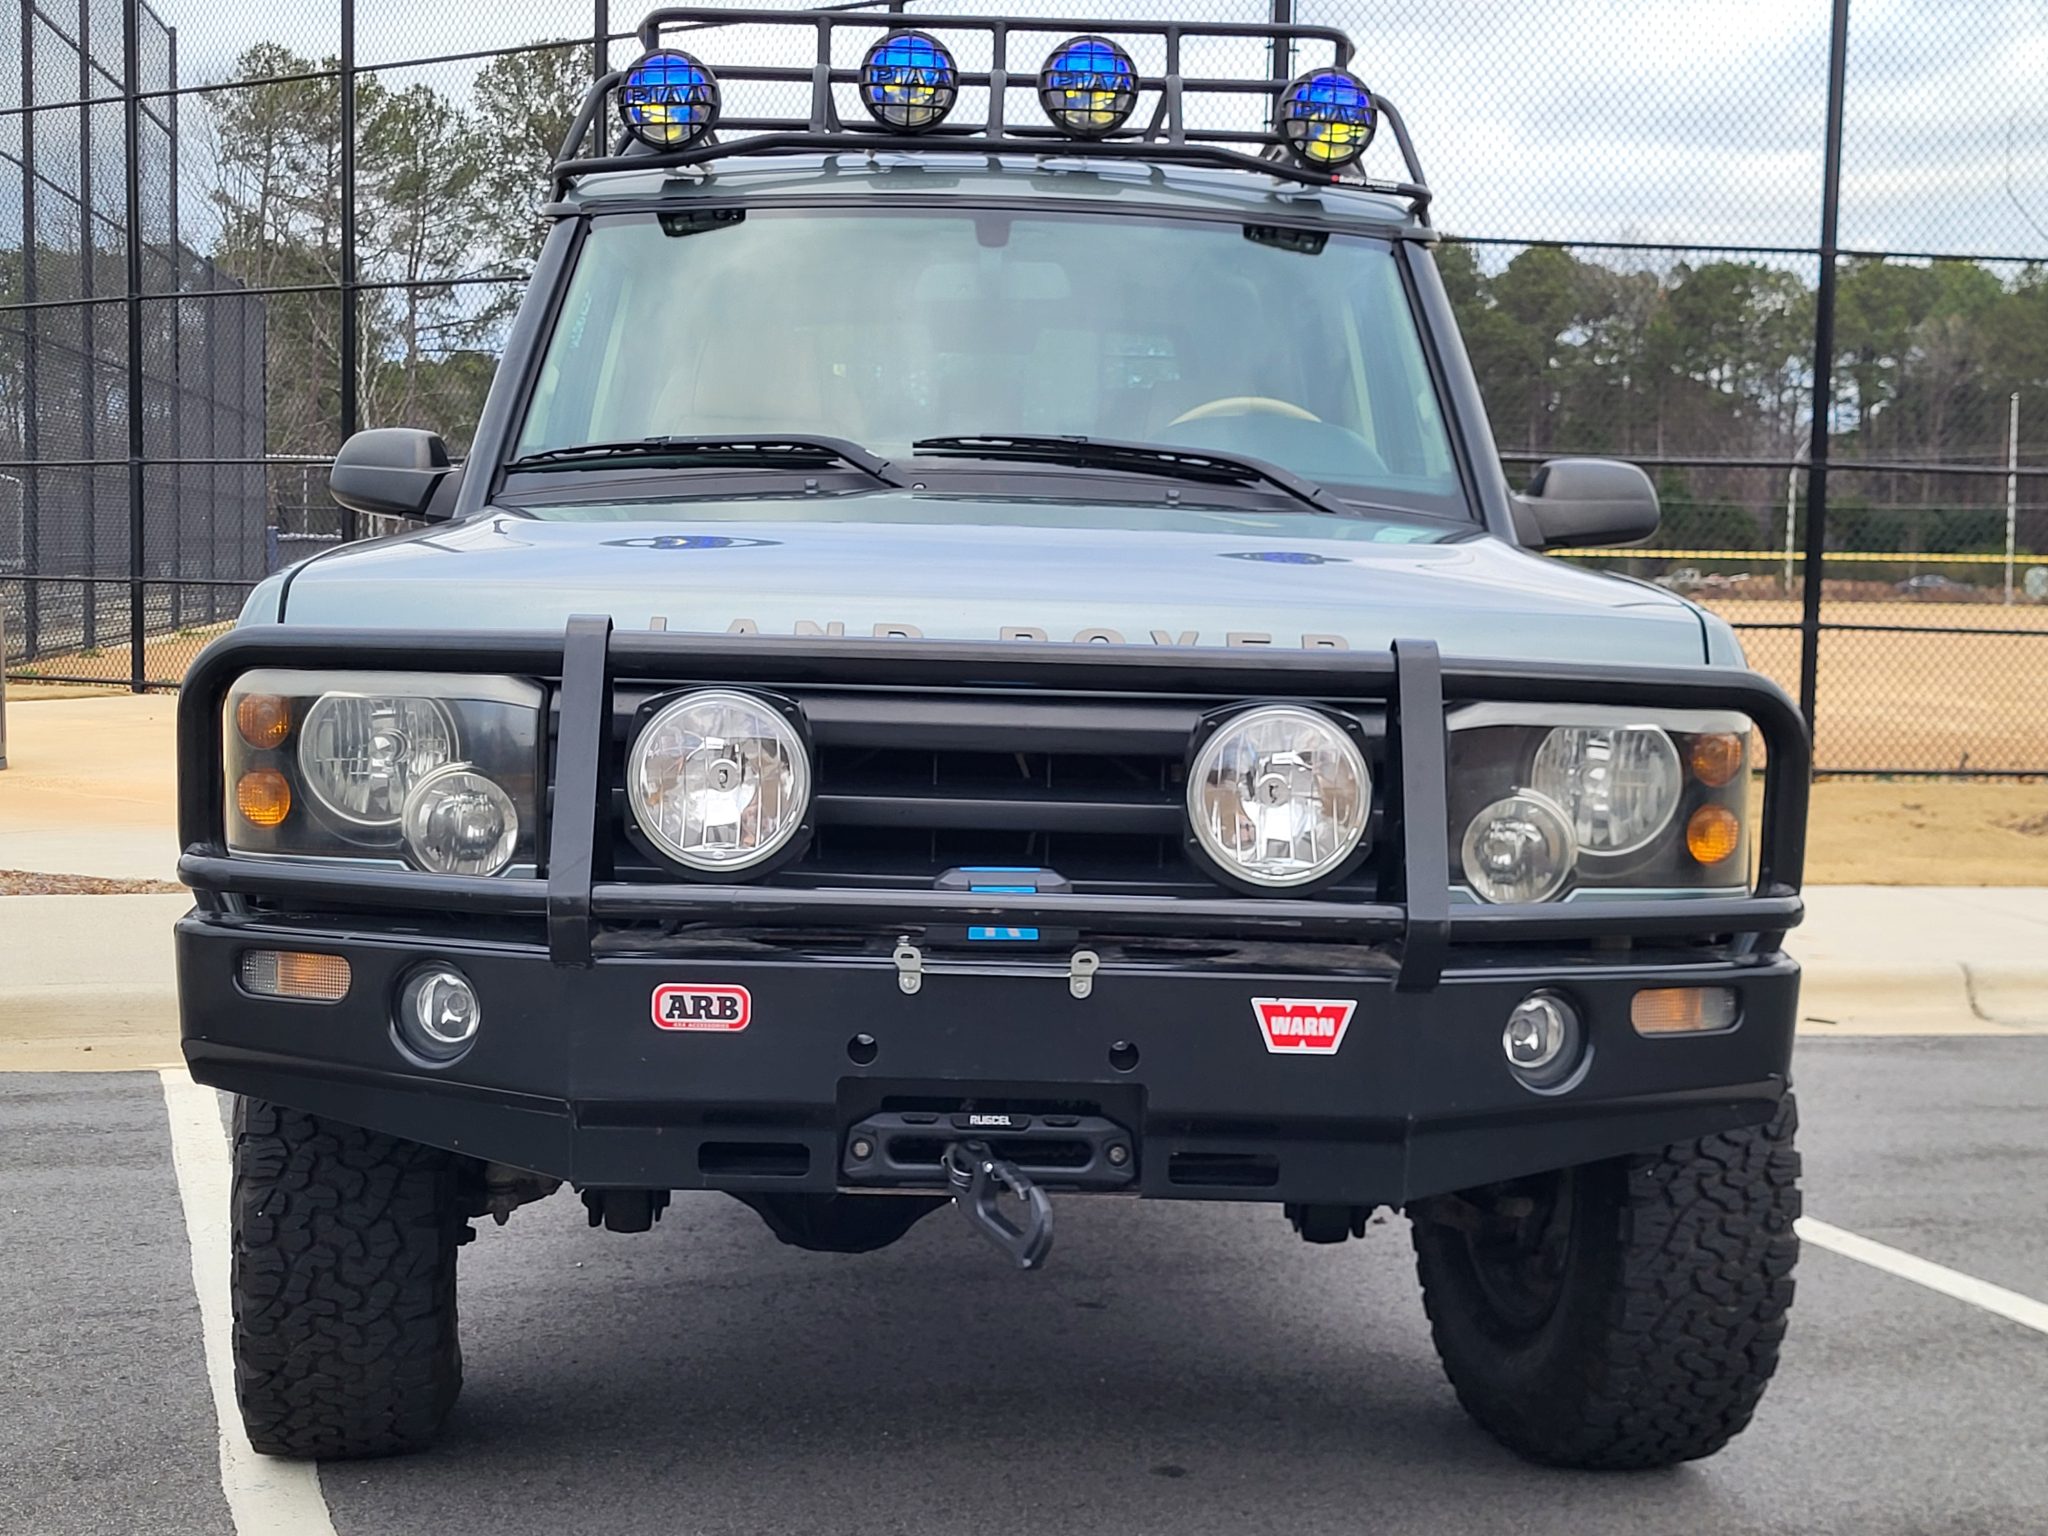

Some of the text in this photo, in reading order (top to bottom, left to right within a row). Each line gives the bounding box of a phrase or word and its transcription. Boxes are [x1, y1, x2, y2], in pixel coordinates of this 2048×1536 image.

[871, 66, 951, 87] PIAA
[626, 84, 706, 104] PIAA
[665, 995, 739, 1020] ARB
[1270, 1016, 1335, 1037] WARN
